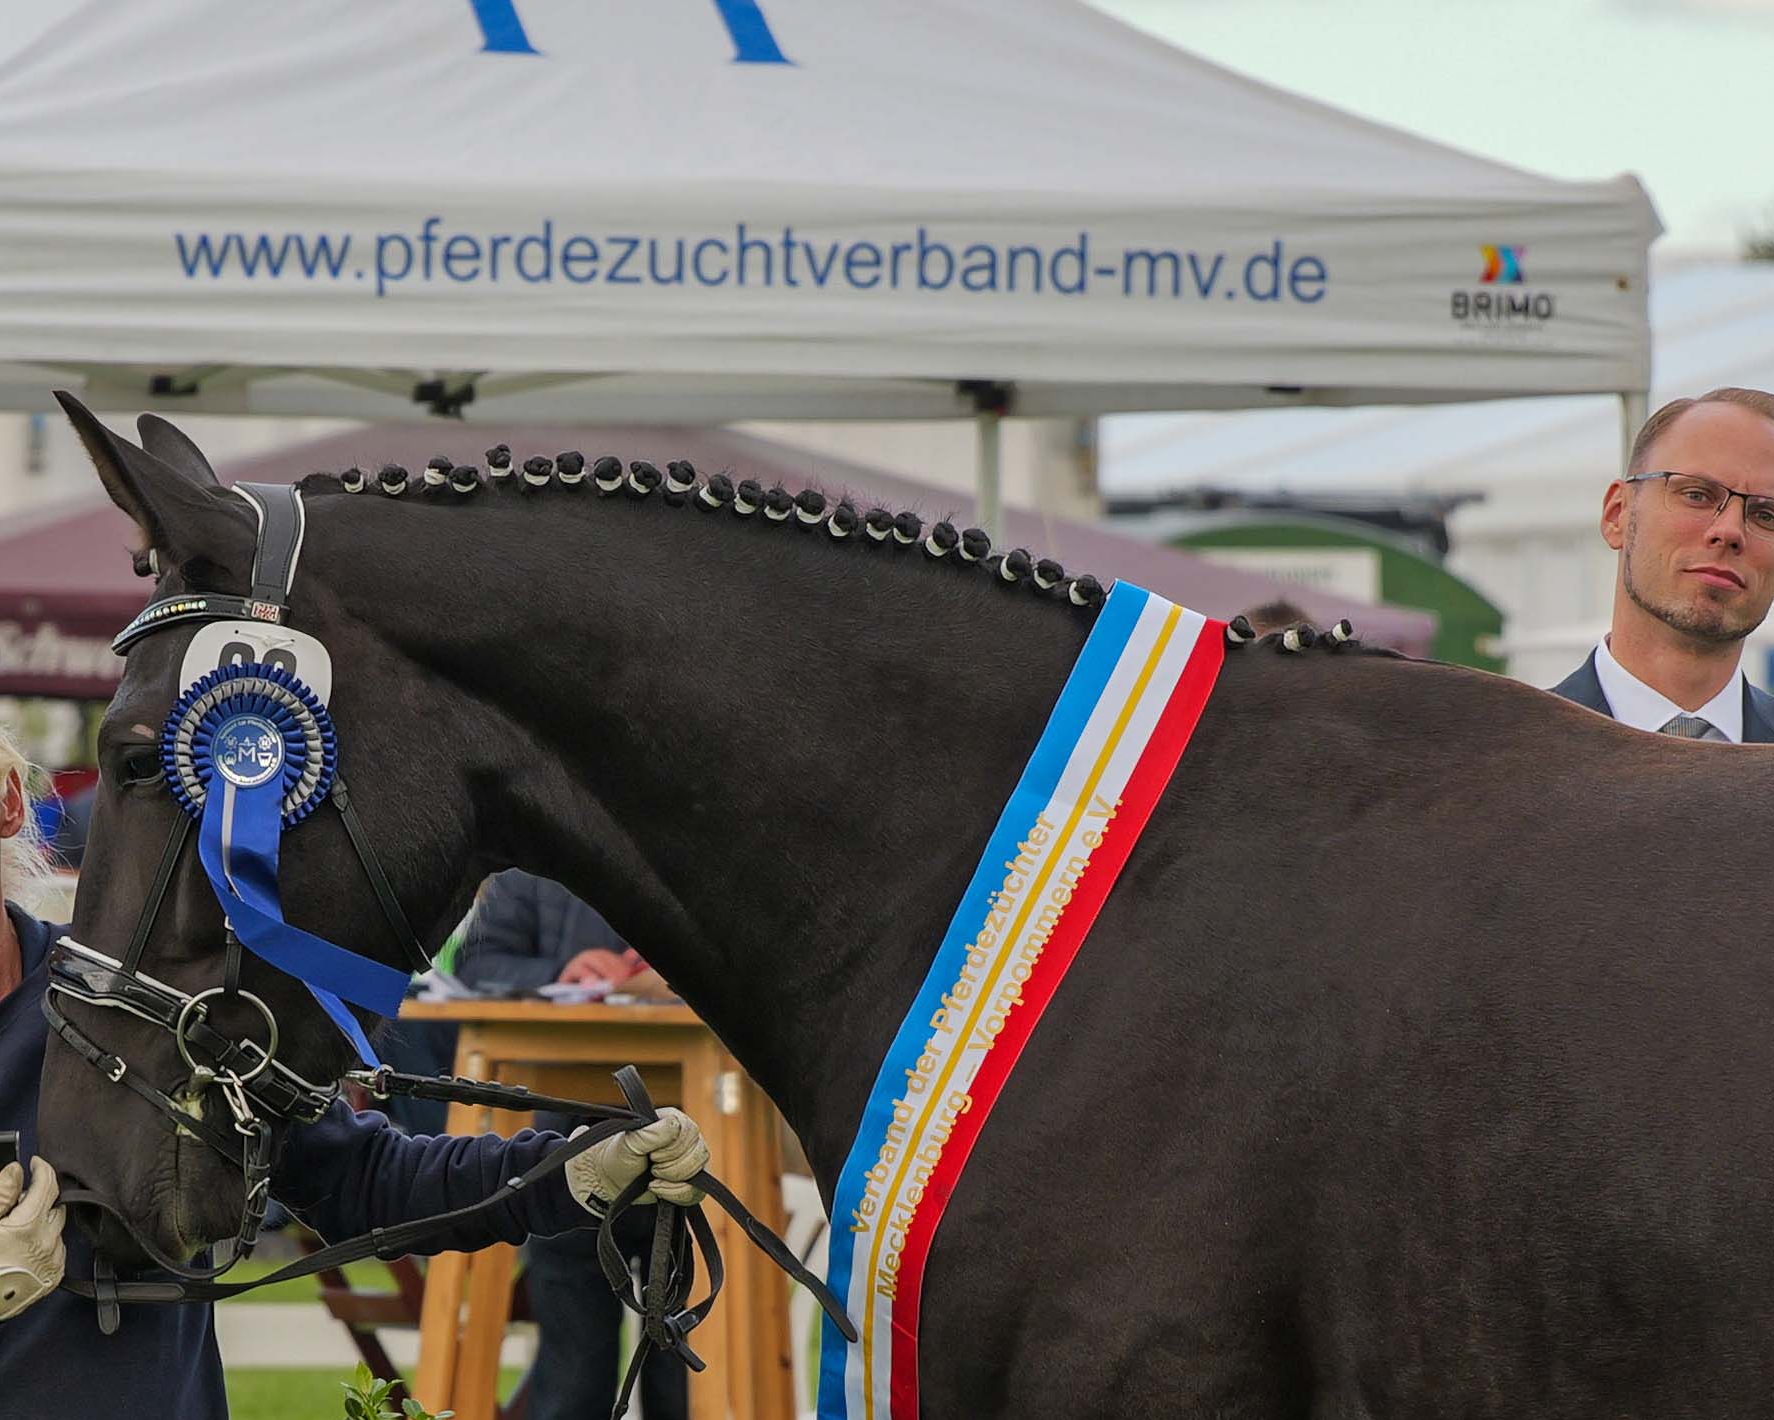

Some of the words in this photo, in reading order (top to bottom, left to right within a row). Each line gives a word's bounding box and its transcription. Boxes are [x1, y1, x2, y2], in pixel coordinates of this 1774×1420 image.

[174, 216, 1329, 304] www.pferdezuchtverband-mv.de
[1450, 291, 1554, 320] BRIMO
[849, 1098, 916, 1232] Verband
[904, 1037, 942, 1095] der
[929, 811, 1055, 1034] Pferdezüchter
[877, 1089, 973, 1301] Mecklenburg
[967, 855, 1091, 1050] Vorpommern
[1082, 794, 1124, 850] e.V.
